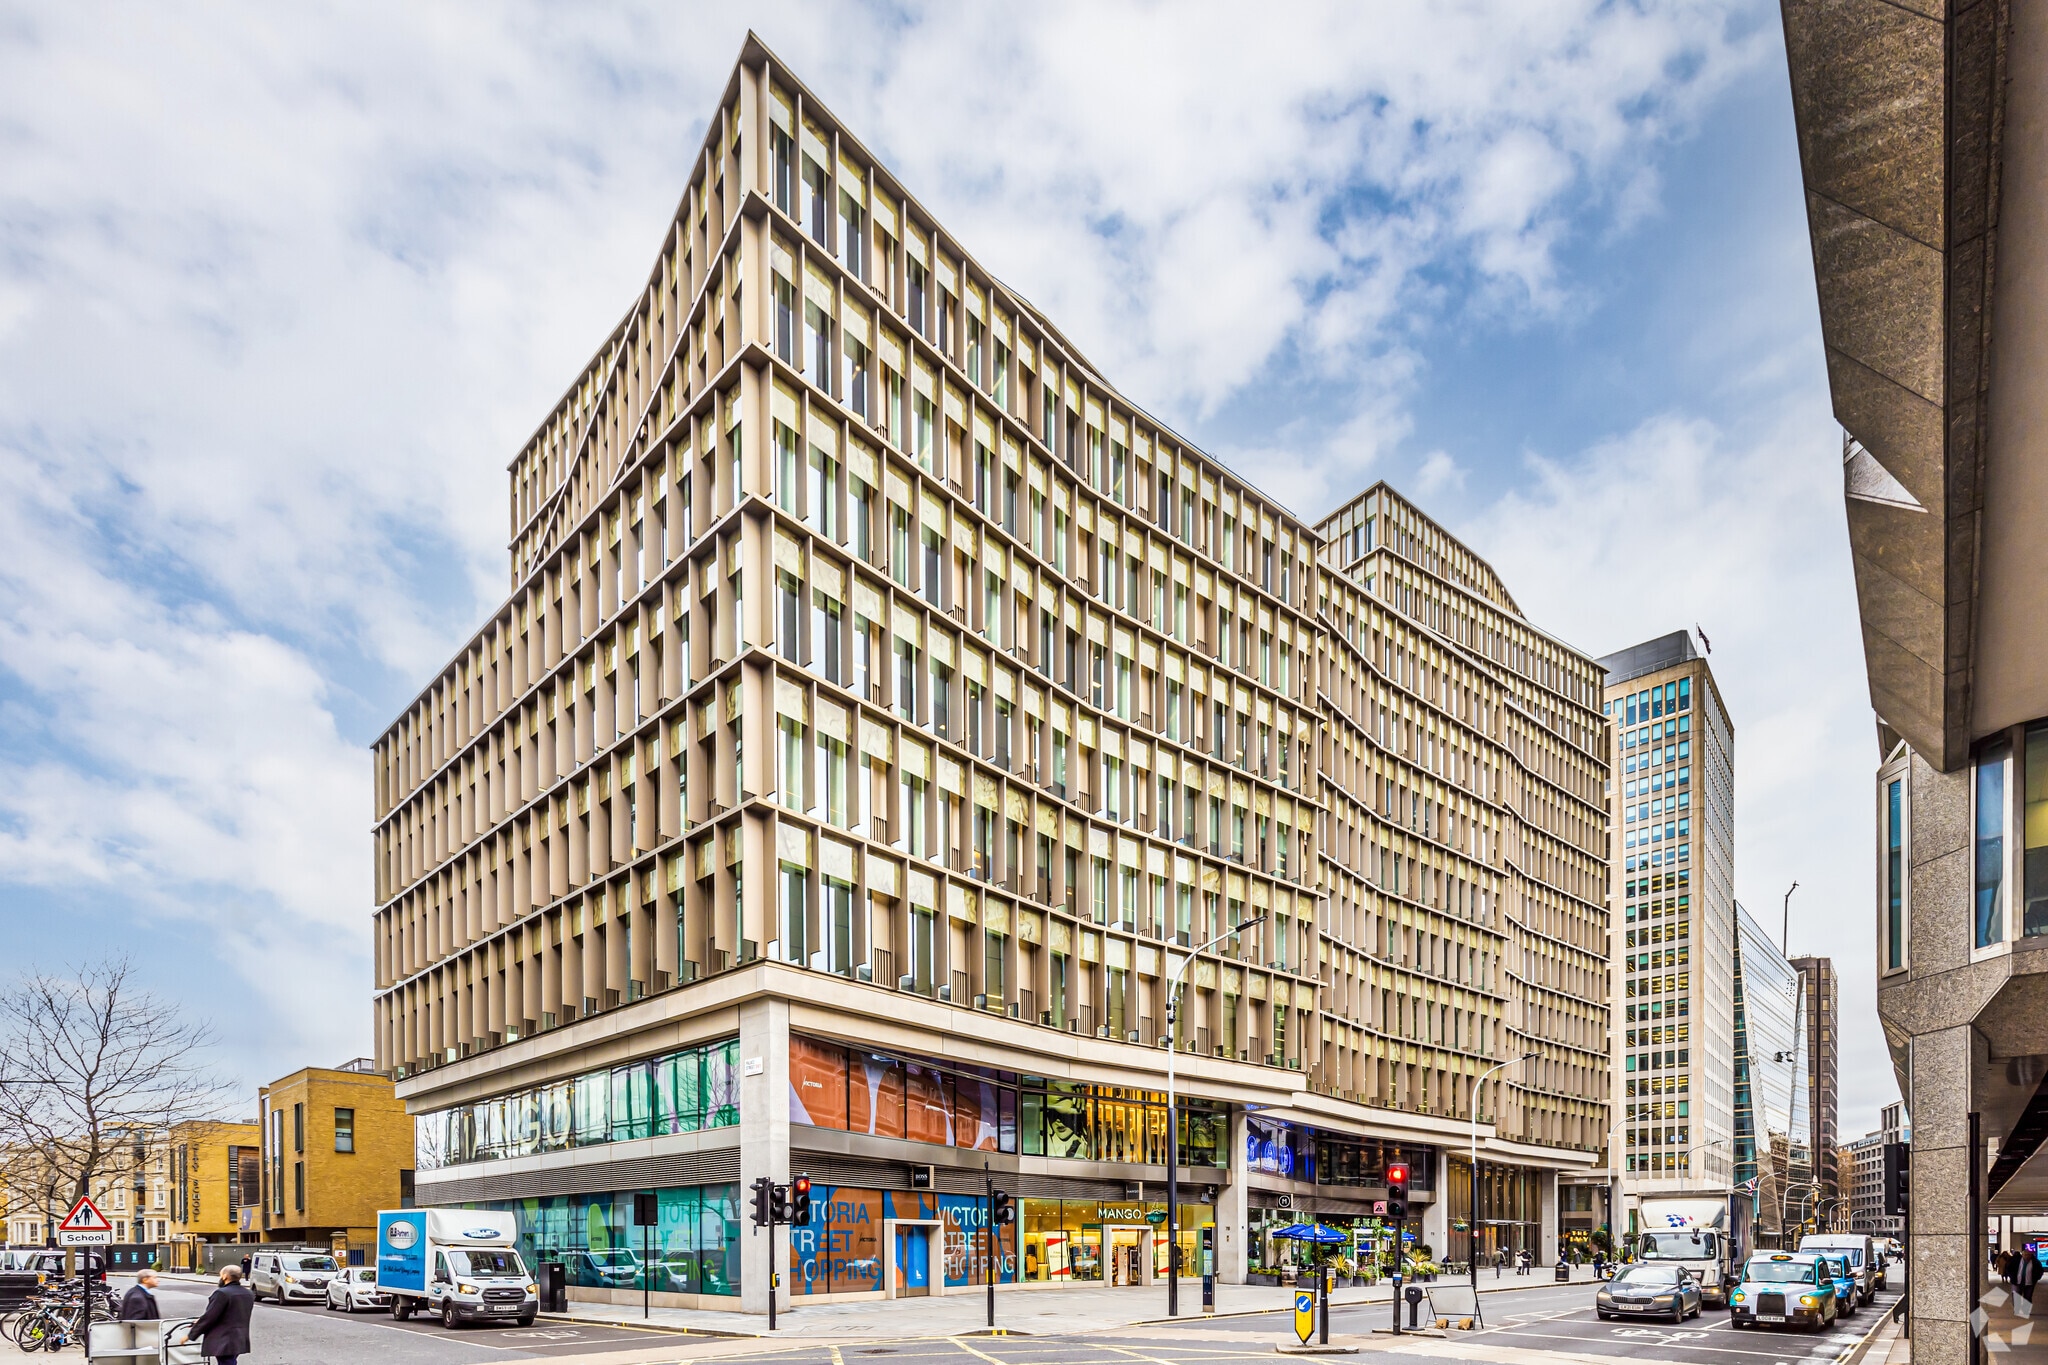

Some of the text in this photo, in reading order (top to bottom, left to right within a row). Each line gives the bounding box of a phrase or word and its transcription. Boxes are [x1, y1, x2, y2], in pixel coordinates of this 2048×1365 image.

[192, 1180, 200, 1222] SCHOOL
[810, 1200, 871, 1225] TORIA
[937, 1206, 1008, 1227] VICTOR
[1097, 1207, 1142, 1220] MANGO
[67, 1234, 105, 1242] School
[790, 1229, 854, 1252] TREET
[944, 1231, 995, 1251] TREE
[790, 1257, 883, 1282] HOPPING
